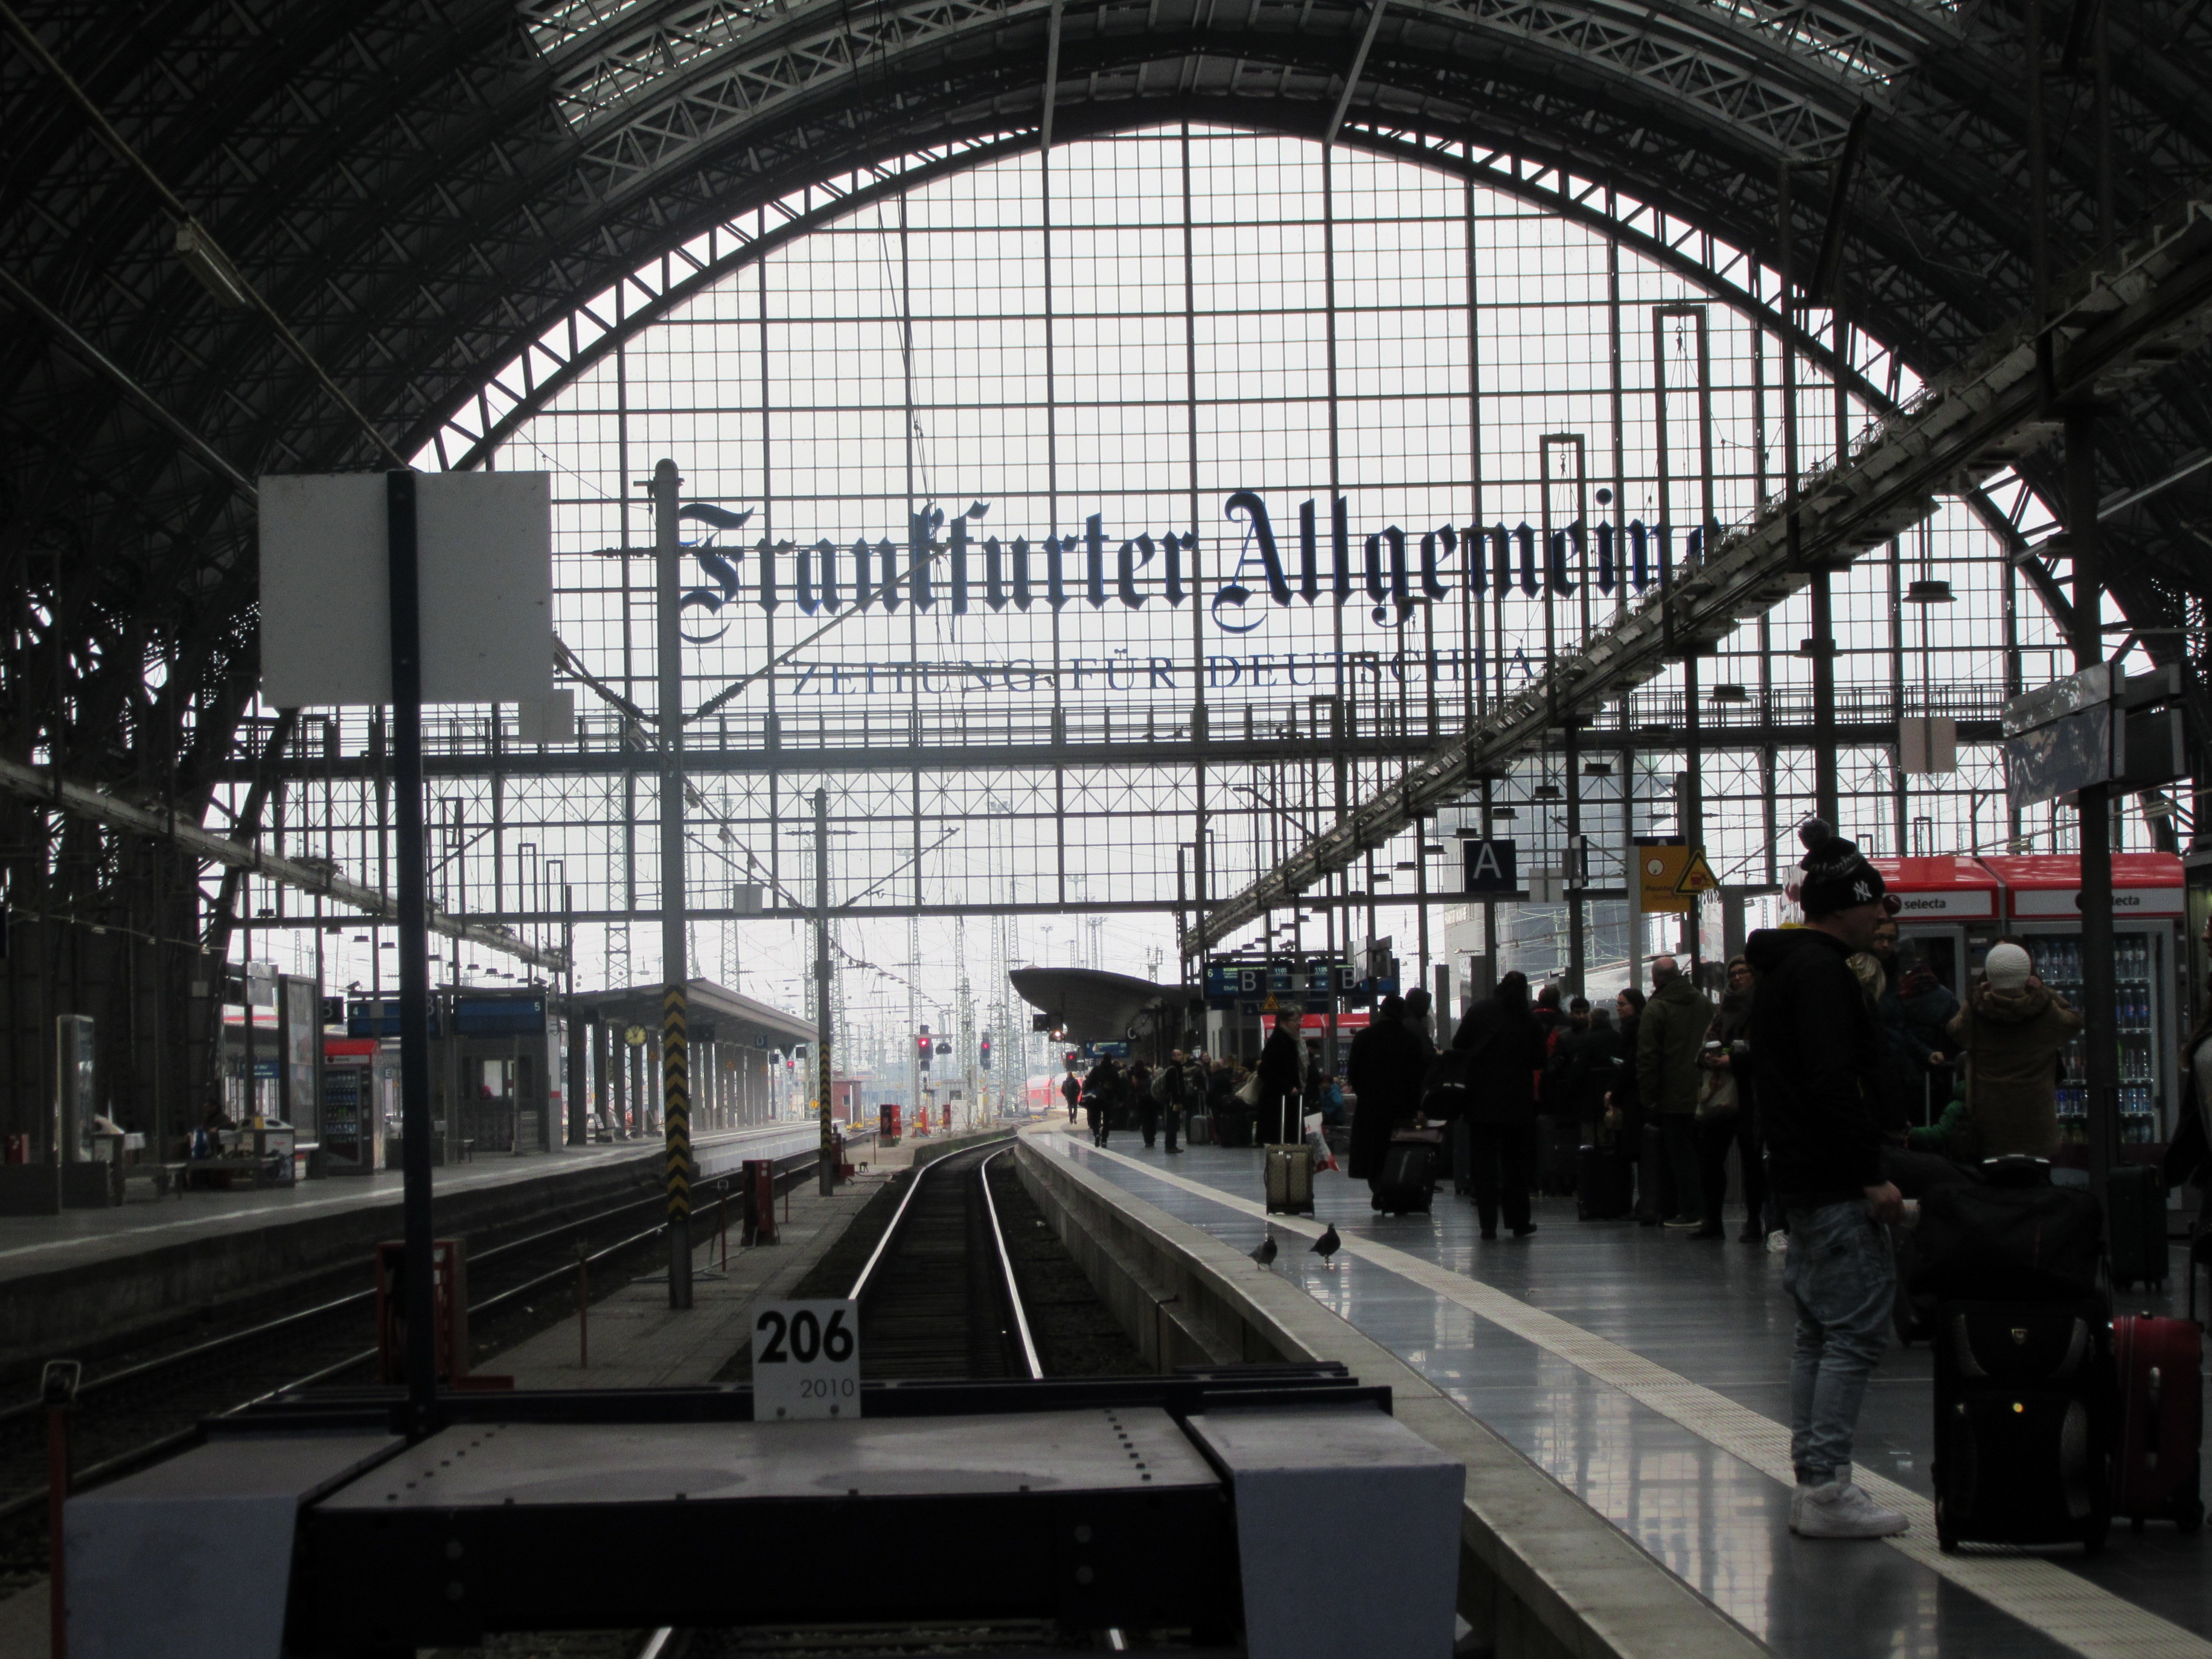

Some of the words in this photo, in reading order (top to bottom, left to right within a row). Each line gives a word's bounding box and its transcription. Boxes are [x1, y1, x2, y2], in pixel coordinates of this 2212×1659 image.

[679, 500, 1199, 644] Frankfurter
[792, 659, 1037, 695] ZEITUNG
[1069, 648, 1178, 690] FÜR
[1205, 646, 1535, 688] DEUTSCHLA
[1473, 843, 1502, 879] A
[1904, 899, 1946, 909] selecta
[2112, 896, 2140, 906] lecta
[1207, 968, 1214, 978] 6
[1242, 971, 1257, 991] B
[1342, 969, 1356, 989] B
[352, 1006, 359, 1016] 4
[534, 1002, 541, 1011] 5
[757, 1310, 853, 1363] 206
[800, 1378, 853, 1398] 2010
